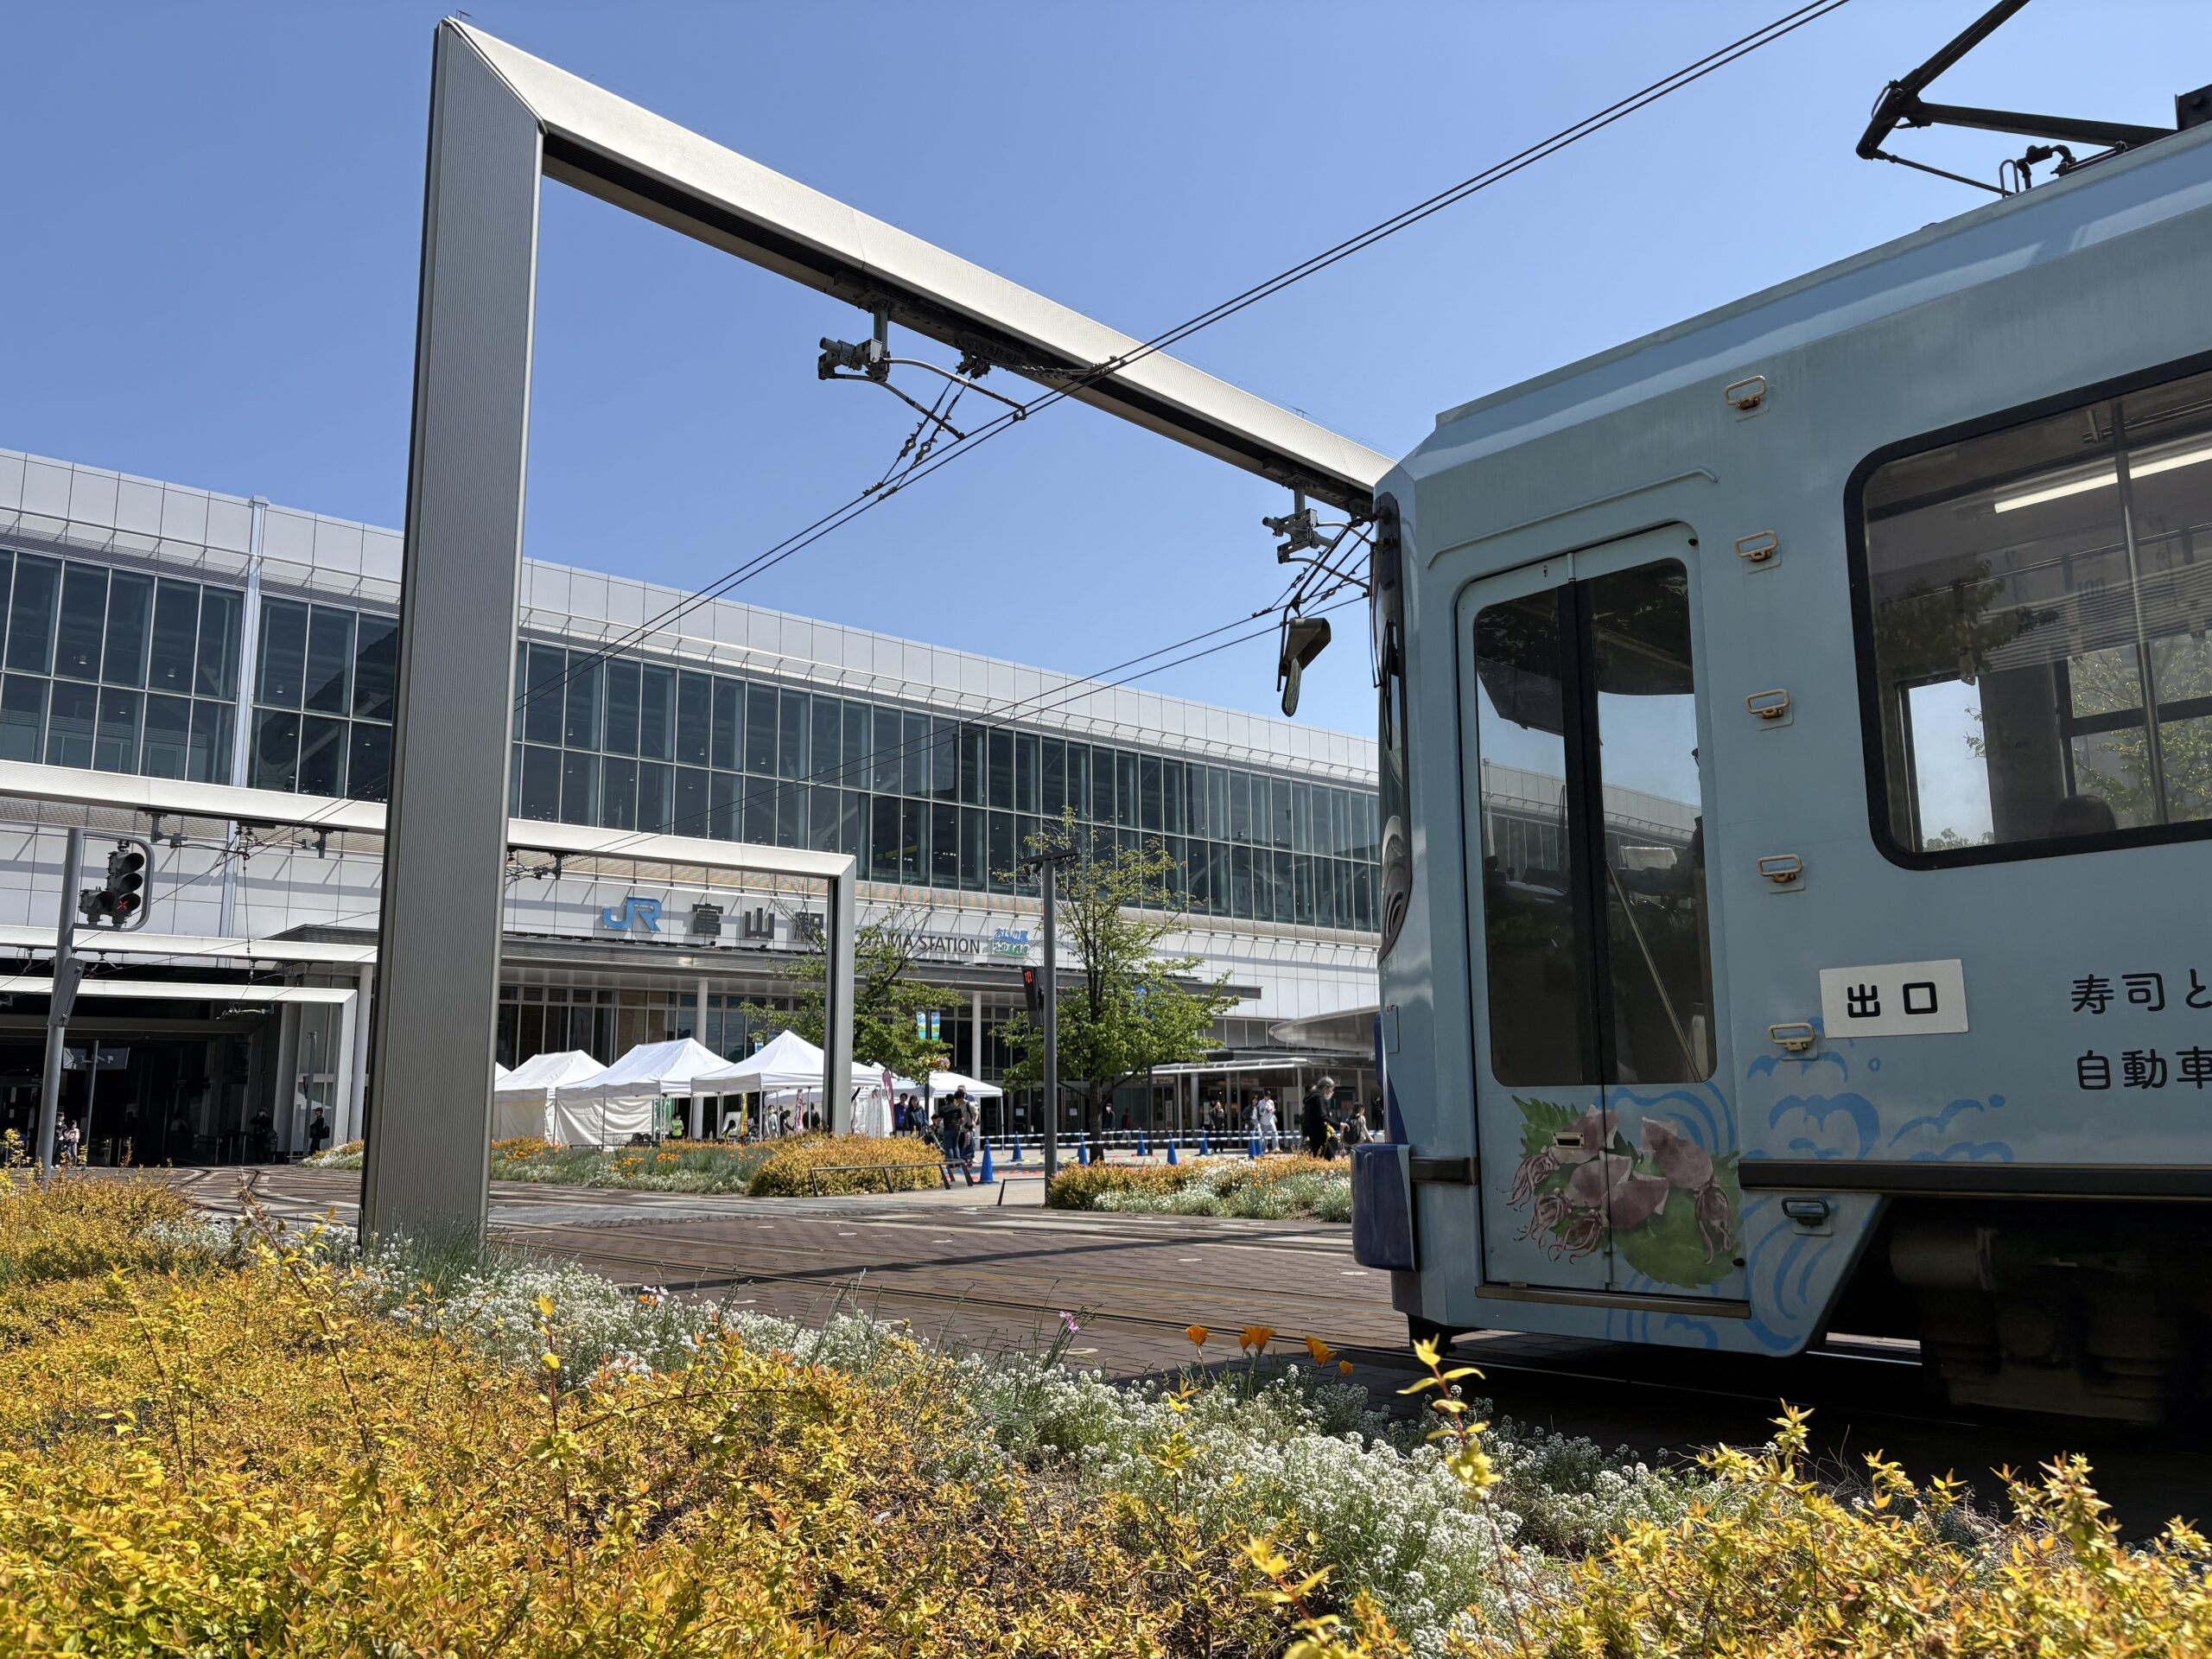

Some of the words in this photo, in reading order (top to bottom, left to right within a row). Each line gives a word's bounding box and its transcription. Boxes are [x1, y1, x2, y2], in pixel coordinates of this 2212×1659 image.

[601, 896, 663, 932] JR
[692, 903, 824, 941] 富山駅
[918, 935, 980, 954] STATION
[1847, 982, 1938, 1018] 出口
[2070, 969, 2212, 1014] 寿司と
[2076, 1046, 2212, 1090] 自動車
